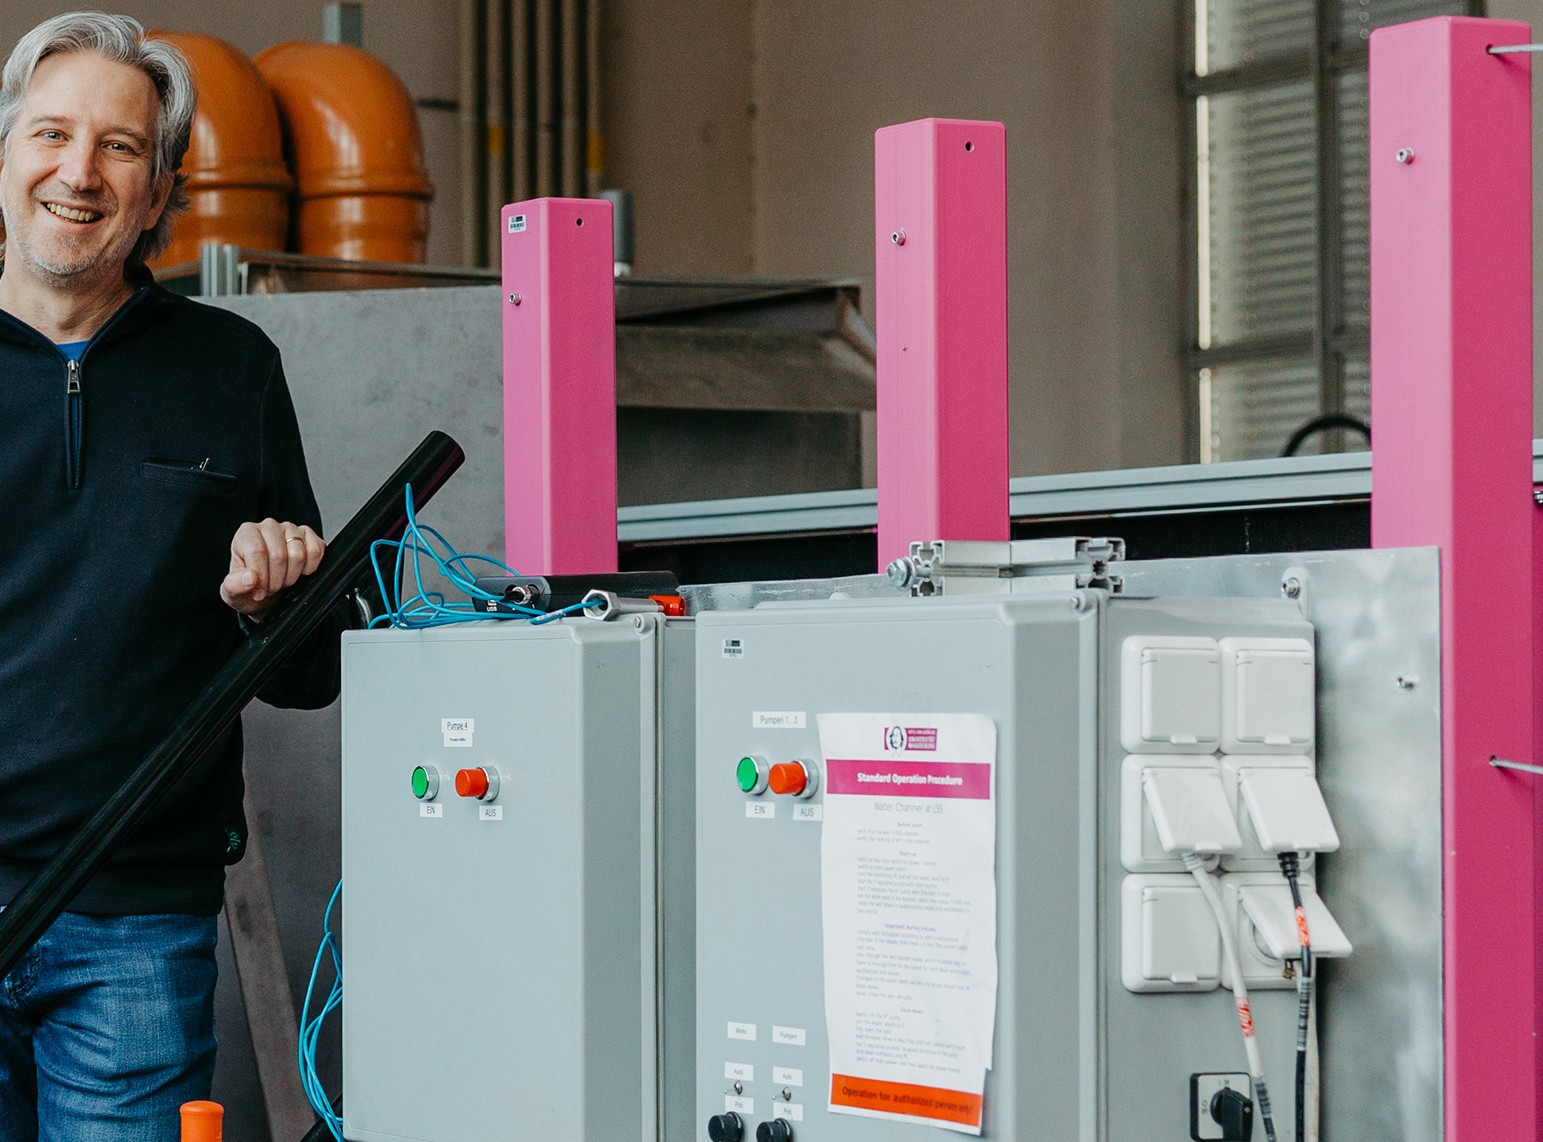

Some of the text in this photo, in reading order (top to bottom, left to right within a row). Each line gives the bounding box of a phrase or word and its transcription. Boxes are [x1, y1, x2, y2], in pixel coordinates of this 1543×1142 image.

[760, 715, 784, 725] Pumpen
[447, 721, 463, 731] Pumpe
[857, 772, 963, 786] Standard Operation Procedure
[426, 806, 435, 814] EIN
[485, 809, 496, 817] AUS
[755, 805, 765, 815] EIN
[800, 808, 814, 817] AUS
[874, 803, 893, 812] Water
[896, 803, 923, 813] Channel
[842, 1087, 877, 1100] Operation
[879, 1091, 891, 1101] for
